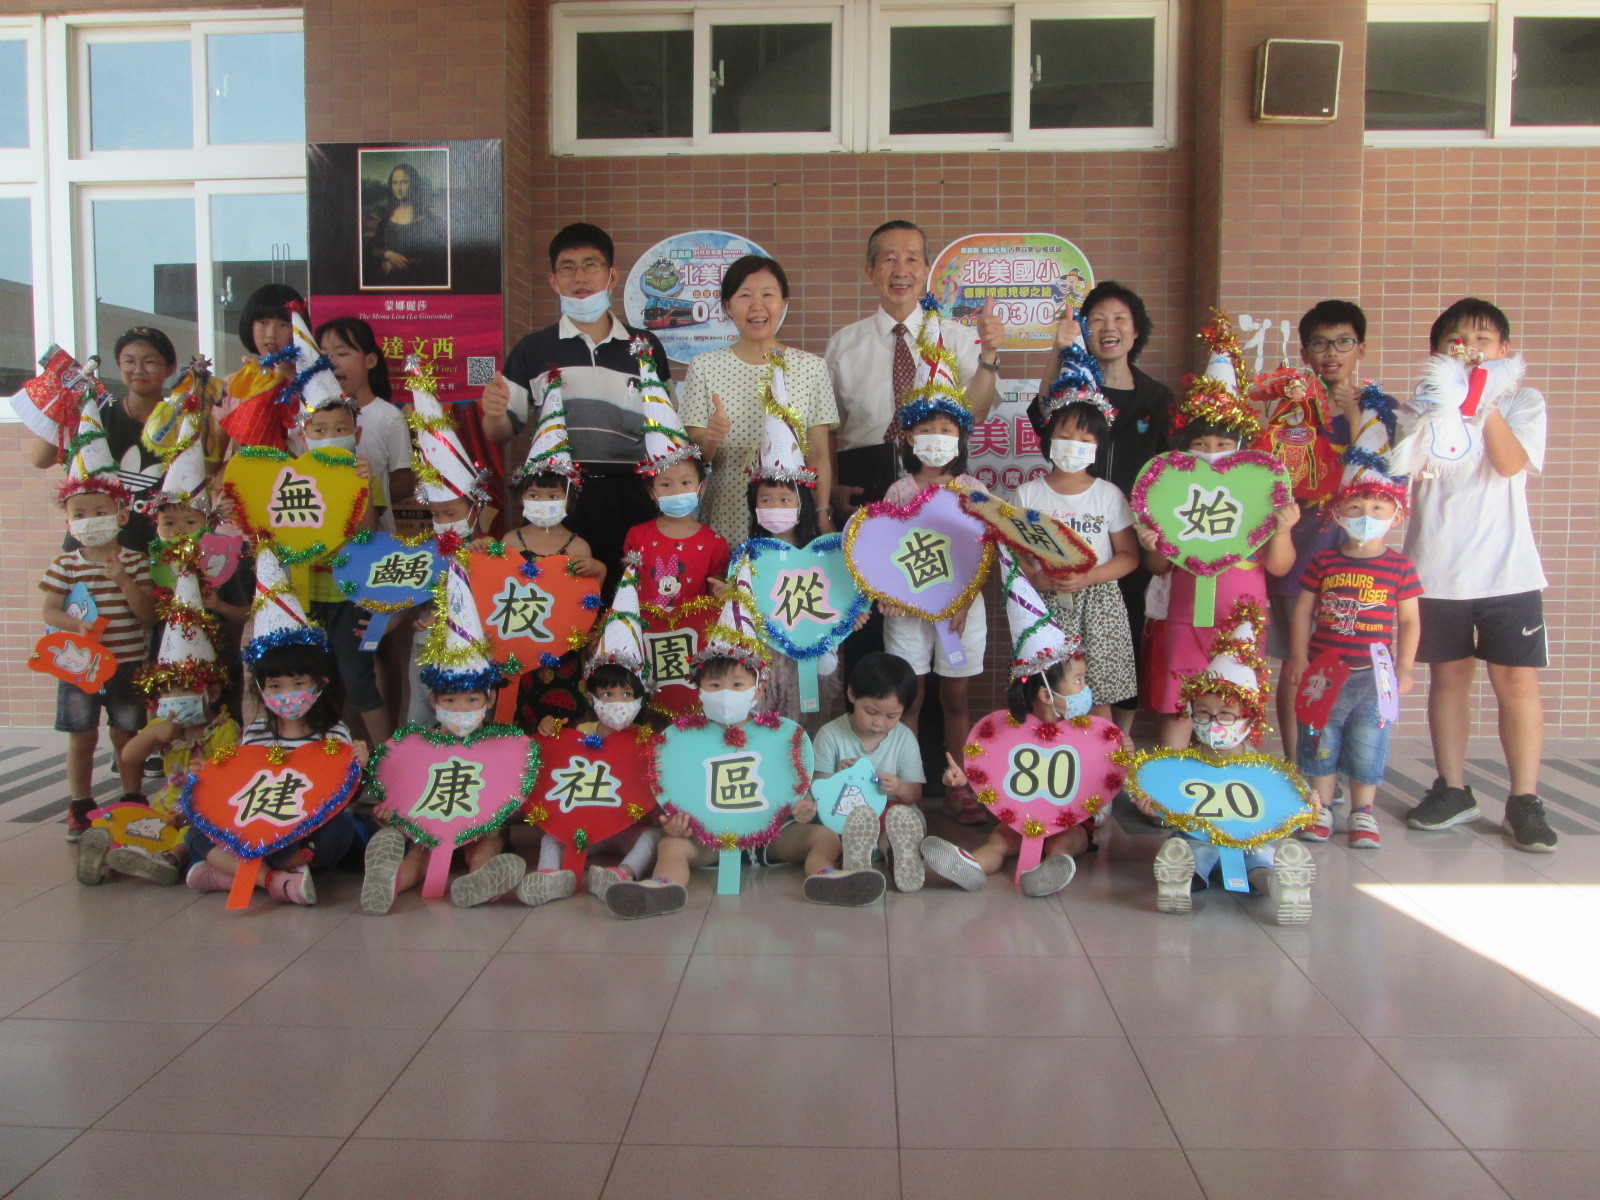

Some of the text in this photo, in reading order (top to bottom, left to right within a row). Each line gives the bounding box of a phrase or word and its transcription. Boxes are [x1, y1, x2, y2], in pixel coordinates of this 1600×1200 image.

[963, 259, 1060, 284] 北美國小
[384, 300, 427, 312] 蒙娜麗莎
[382, 336, 454, 360] 達文西
[435, 364, 458, 373] Vinci
[270, 471, 322, 524] 無
[1179, 488, 1238, 536] 始
[897, 531, 951, 589] 齒
[1010, 519, 1064, 557] 開
[371, 553, 429, 587] 齲
[489, 581, 551, 641] 校
[774, 571, 836, 627] 從
[648, 633, 694, 682] 園
[236, 772, 308, 823] 健
[414, 759, 479, 819] 康
[551, 760, 617, 809] 社
[710, 755, 765, 810] 區
[1009, 747, 1076, 800] 80
[1183, 781, 1260, 819] 20
